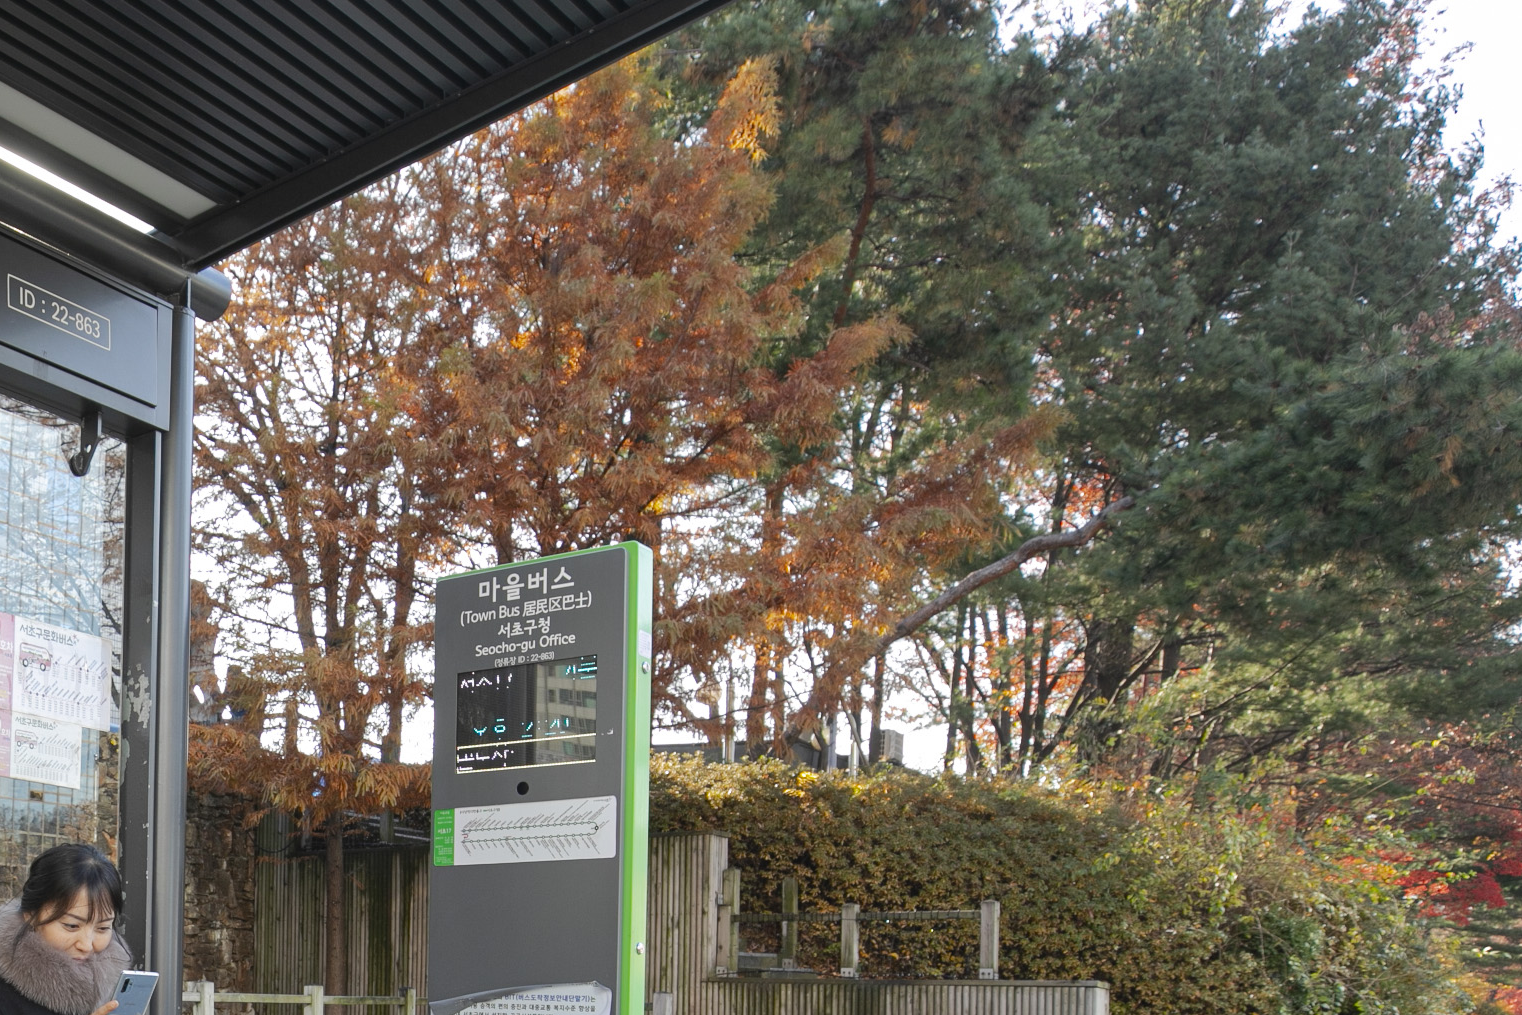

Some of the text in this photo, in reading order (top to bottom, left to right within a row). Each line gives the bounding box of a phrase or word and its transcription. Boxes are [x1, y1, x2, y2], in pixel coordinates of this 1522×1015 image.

[19, 286, 101, 338] ID : 22-863
[478, 566, 575, 603] 마을버스
[460, 590, 592, 627] (Town Bus 居民区巴士)
[19, 624, 74, 647] 서초구문화버스
[497, 616, 551, 638] 서초구청
[475, 633, 576, 657] Seocho-gu Office
[494, 657, 516, 668] (정류장
[530, 651, 555, 662] 22-863)
